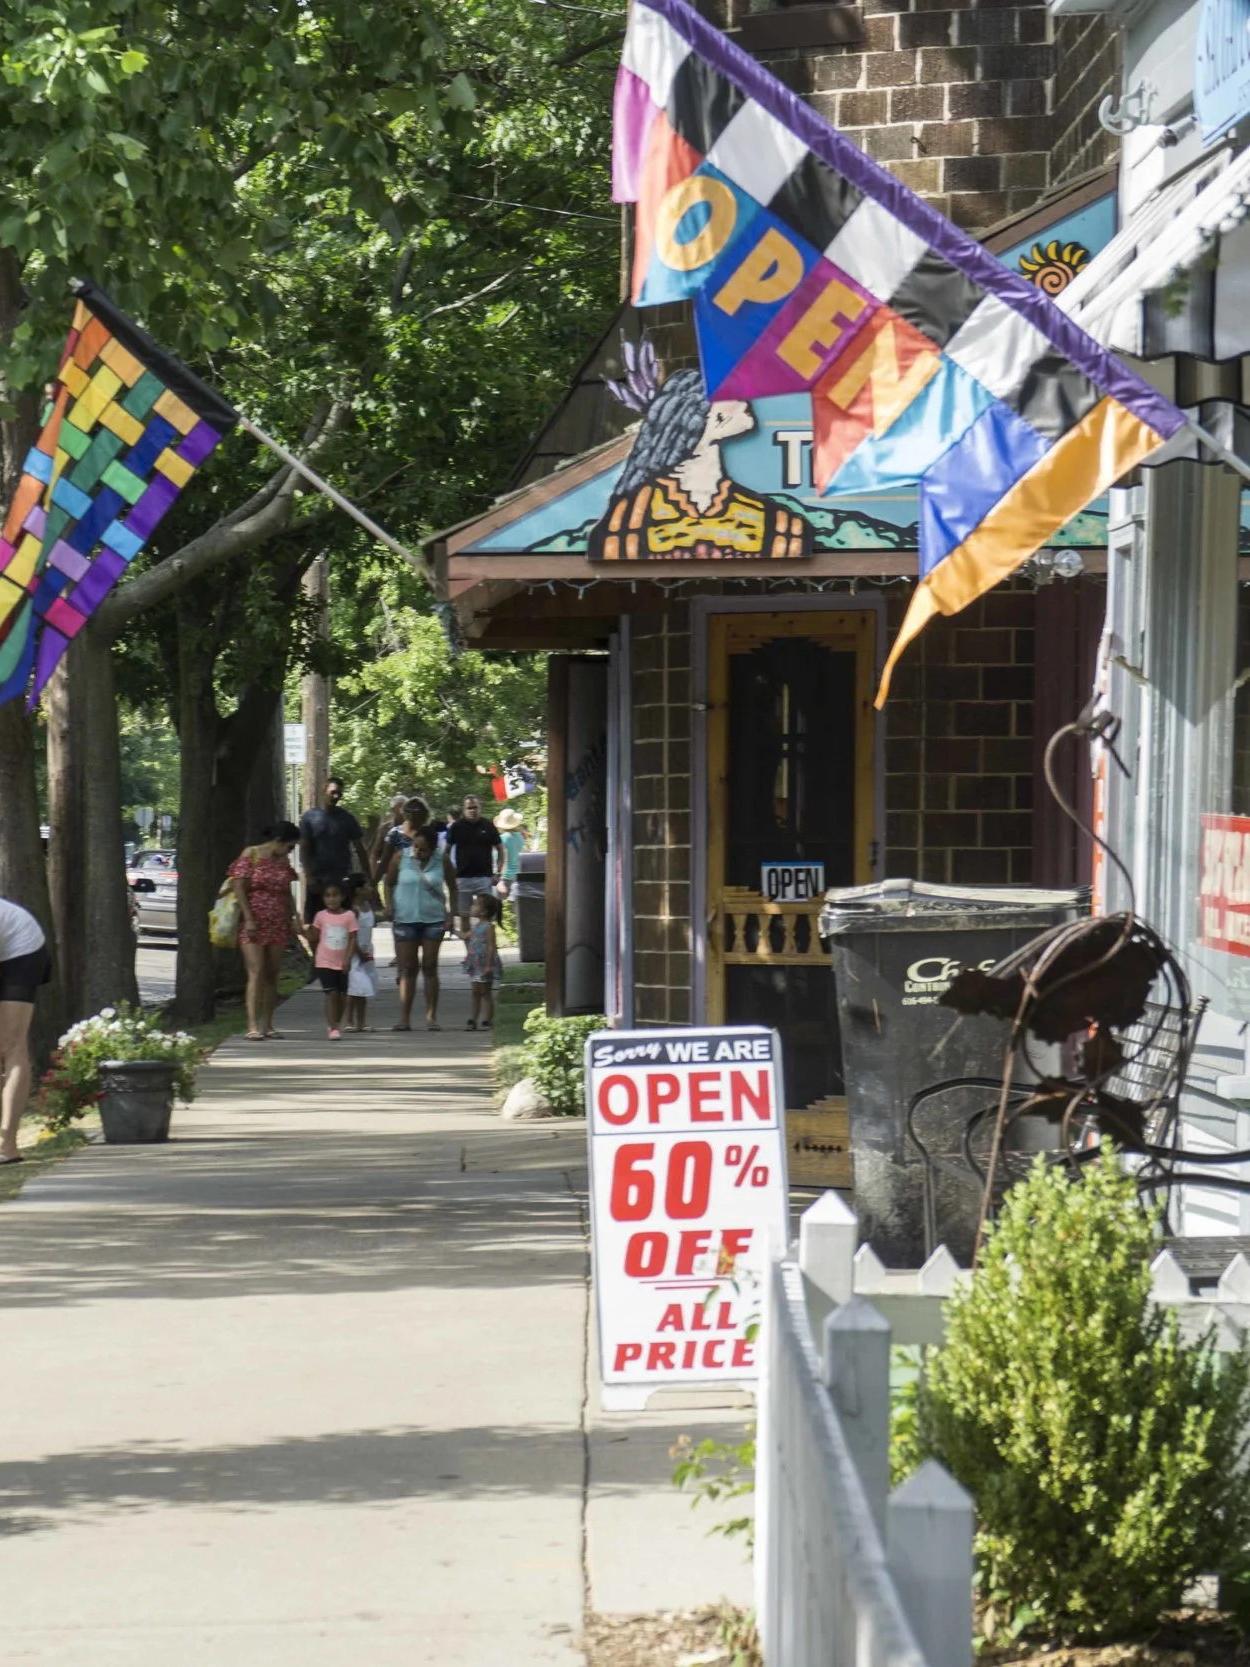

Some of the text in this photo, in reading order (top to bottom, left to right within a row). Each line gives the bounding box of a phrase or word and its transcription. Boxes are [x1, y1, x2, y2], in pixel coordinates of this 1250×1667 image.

[656, 176, 942, 440] OPEN
[768, 867, 819, 900] OPEN
[593, 1039, 771, 1068] Sorry WE ARE
[598, 1069, 771, 1126] OPEN
[609, 1141, 770, 1222] 60%
[624, 1229, 753, 1278] OFF
[656, 1302, 737, 1332] ALL
[613, 1339, 755, 1371] PRICE
